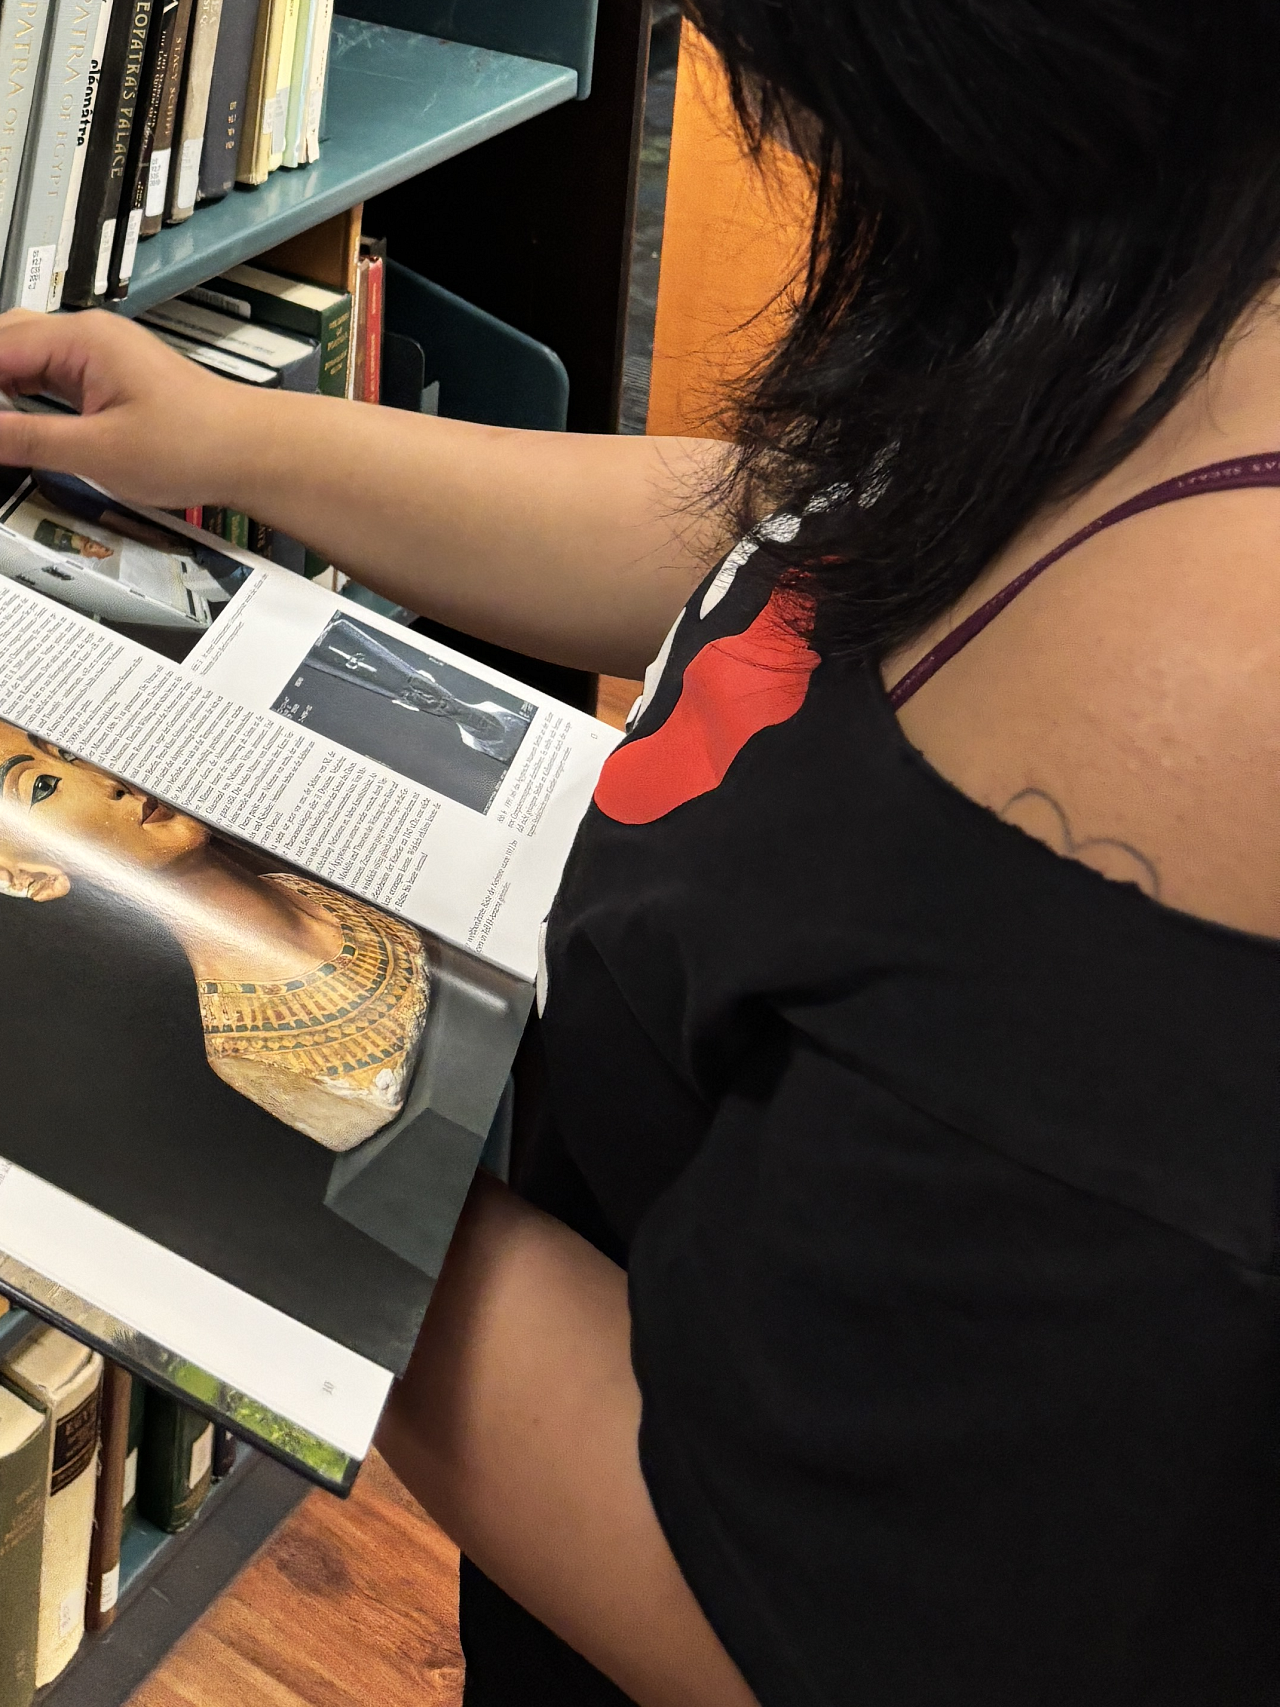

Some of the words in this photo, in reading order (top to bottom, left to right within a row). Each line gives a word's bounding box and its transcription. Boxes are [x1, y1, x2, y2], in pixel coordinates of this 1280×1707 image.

[0, 107, 19, 137] OF
[58, 94, 75, 124] OF
[47, 130, 70, 201] EGYPT
[110, 106, 135, 179] PALACE
